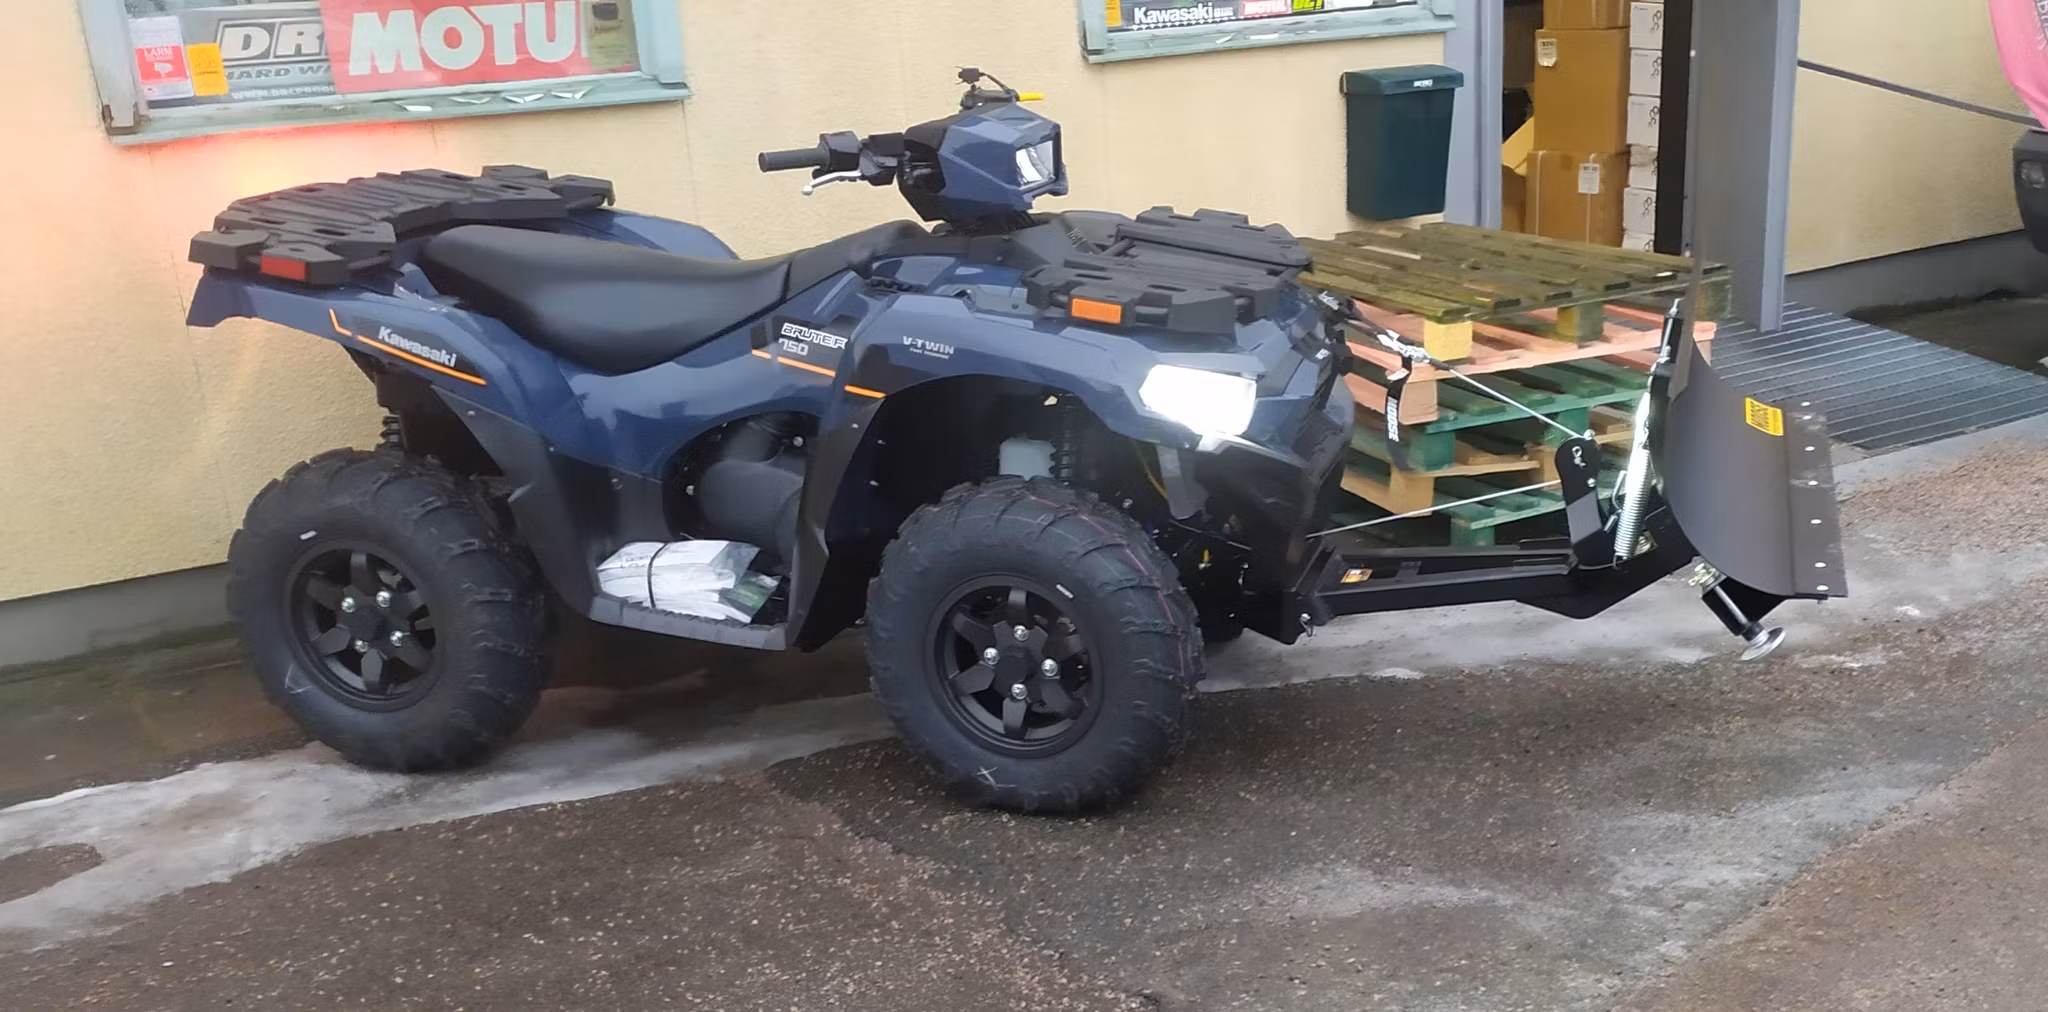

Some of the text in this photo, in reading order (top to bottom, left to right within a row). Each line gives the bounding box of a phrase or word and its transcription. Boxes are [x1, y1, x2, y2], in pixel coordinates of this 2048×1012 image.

[1133, 2, 1214, 25] Kawasaki
[377, 325, 457, 368] Kawasaki
[778, 337, 809, 356] 750
[902, 335, 955, 355] V-TWIN
[1386, 395, 1400, 443] MOOSE
